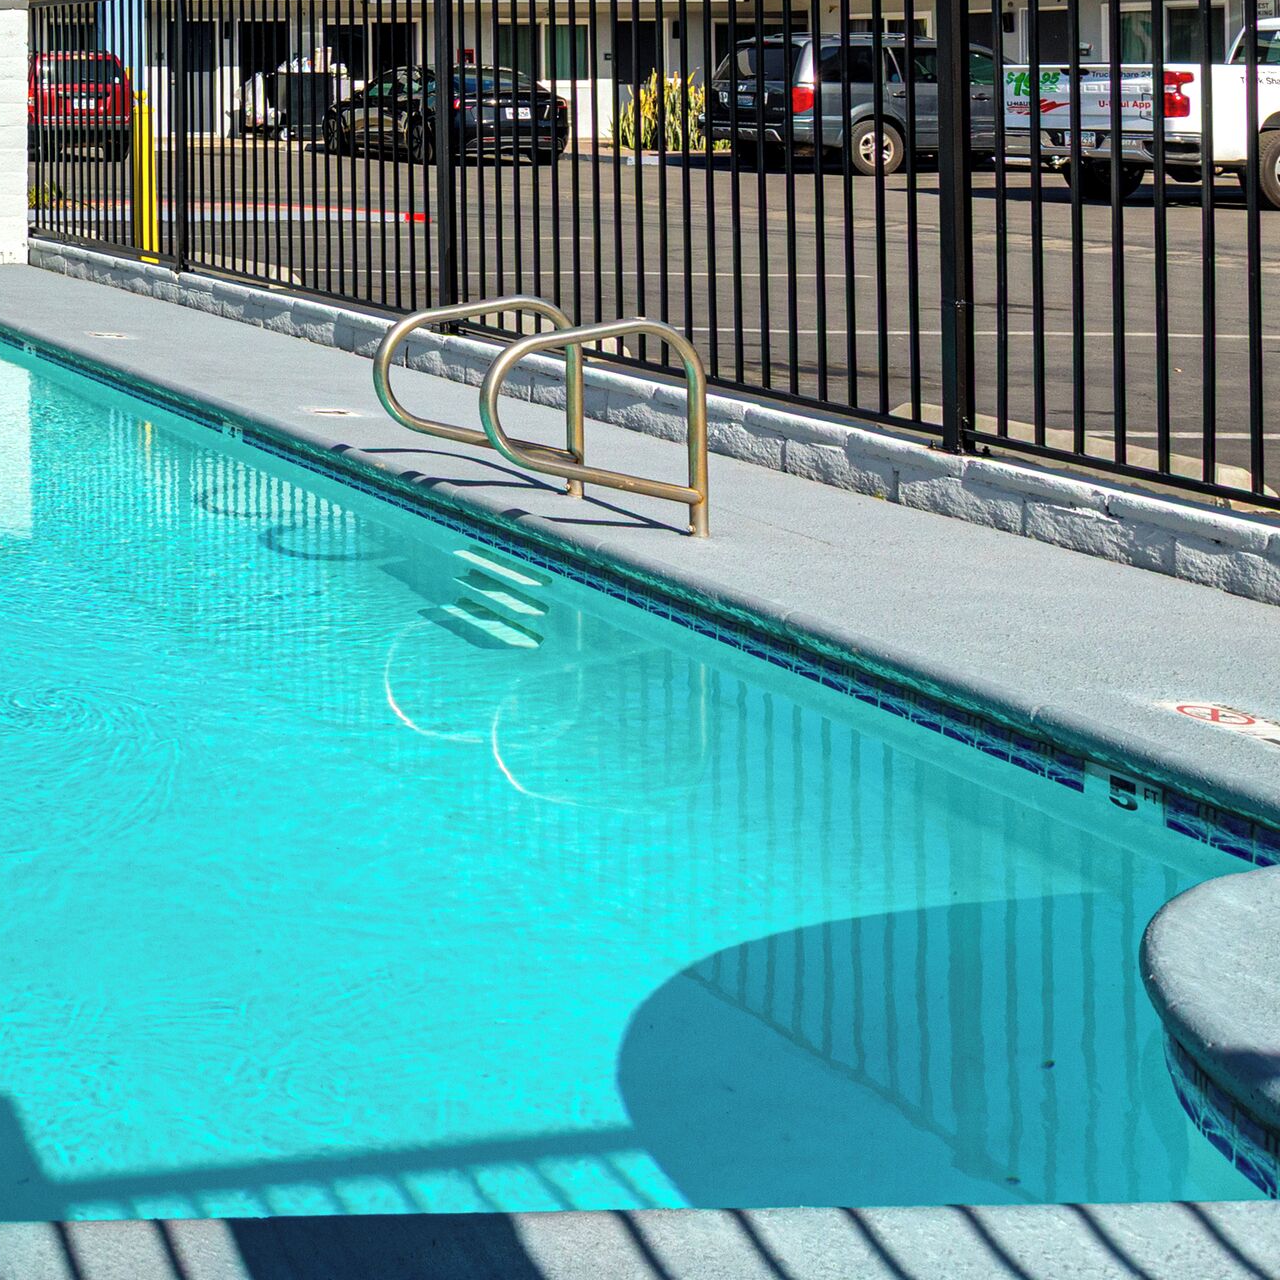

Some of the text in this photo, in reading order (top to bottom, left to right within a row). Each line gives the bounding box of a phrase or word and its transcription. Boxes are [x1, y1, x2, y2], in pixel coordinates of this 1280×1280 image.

[1132, 100, 1151, 109] App
[1108, 774, 1159, 811] 5 FT
